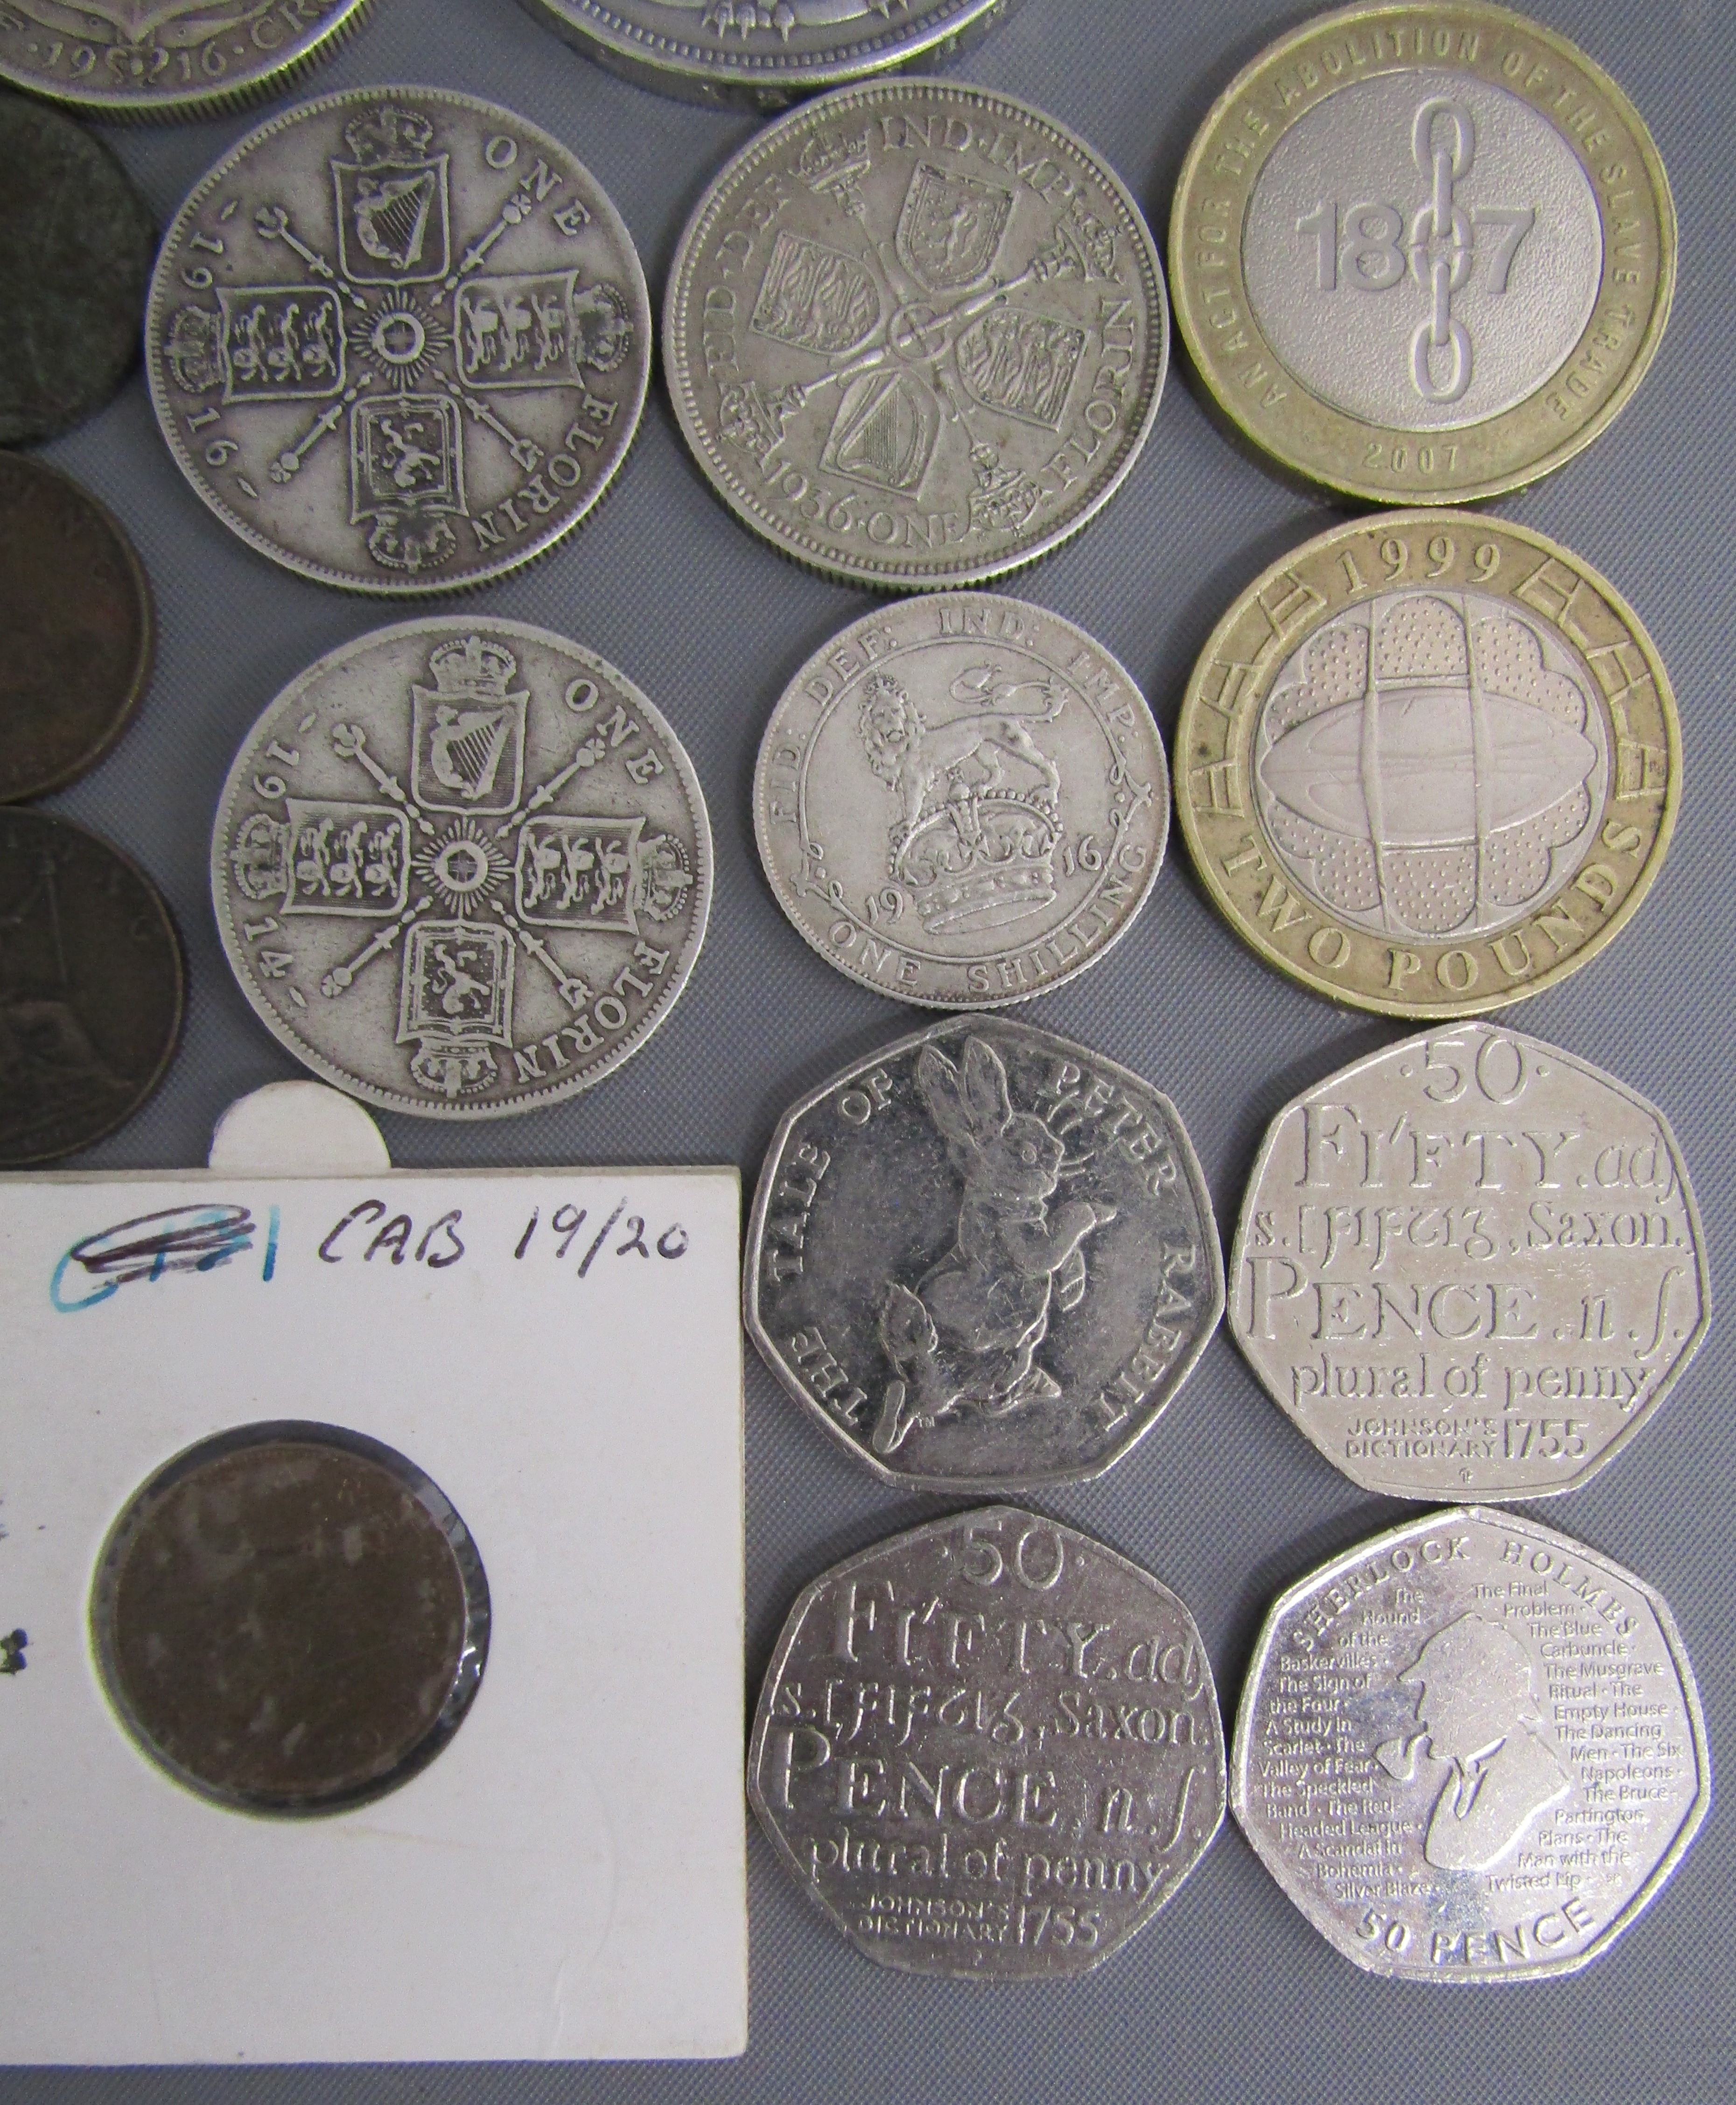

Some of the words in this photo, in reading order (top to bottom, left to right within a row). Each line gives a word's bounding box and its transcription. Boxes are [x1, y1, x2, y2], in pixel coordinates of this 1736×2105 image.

[1274, 27, 1480, 109] ABOLITION
[1502, 50, 1549, 89] OF
[1551, 87, 1613, 154] THE
[1214, 109, 1269, 176] THE
[486, 134, 592, 236] ONE
[1196, 195, 1231, 268] FOR
[1598, 162, 1642, 285] SLAVE
[1202, 286, 1248, 353] ACT
[1545, 303, 1637, 421] TRADE
[1238, 362, 1288, 409] AN
[866, 510, 973, 550] ONE
[1045, 295, 1136, 495] FLORIN
[1362, 442, 1458, 474] 2007
[471, 393, 620, 552] FLORIN
[1337, 535, 1501, 594] 1999
[565, 678, 665, 784] ONE
[864, 886, 904, 926] 19
[1061, 835, 1103, 877] 16
[828, 920, 922, 988] ONE
[967, 845, 1148, 993] SHILLING
[1220, 835, 1351, 969] TWO
[1387, 819, 1642, 991] POUNDS
[513, 940, 671, 1084] FLORIN
[841, 1067, 894, 1127] OF
[1049, 1061, 1176, 1197] PETER
[768, 1142, 831, 1284] TALE
[319, 1199, 467, 1268] CAB
[514, 1195, 691, 1279] 19/20
[1097, 1240, 1198, 1433] RABBIT
[792, 1324, 868, 1426] THE
[1291, 1352, 1432, 1411] plural
[1442, 1352, 1493, 1399] of
[1346, 1439, 1498, 1459] DICTIONARY
[1503, 1417, 1590, 1460] 1755
[1347, 1417, 1498, 1438] JOHNSON'S
[1292, 1537, 1470, 1652] SHERLOCK
[1498, 1540, 1641, 1638] HOLMES
[1394, 1586, 1425, 1605] The
[1475, 1582, 1506, 1600] The
[1508, 1579, 1550, 1598] Final
[1362, 1607, 1421, 1627] Hound
[1503, 1600, 1577, 1619] Problem
[1338, 1631, 1358, 1648] of
[1360, 1631, 1389, 1648] the
[1528, 1621, 1561, 1639] The
[1562, 1620, 1603, 1638] Blue
[1279, 1651, 1378, 1672] Baskervilles
[1540, 1639, 1629, 1660] Carbuncle
[1279, 1675, 1308, 1693] The
[1312, 1671, 1351, 1695] Sign
[1353, 1672, 1372, 1690] of
[1543, 1662, 1578, 1680] The
[1580, 1660, 1666, 1681] Musgrave
[1269, 1697, 1298, 1714] the
[1302, 1696, 1340, 1714] Four
[1549, 1681, 1598, 1702] Ritual
[1610, 1680, 1645, 1698] The
[1265, 1719, 1279, 1736] A
[1283, 1715, 1332, 1737] Study
[1335, 1715, 1352, 1733] in
[1553, 1704, 1610, 1724] Empty
[1613, 1701, 1670, 1719] House
[1263, 1738, 1322, 1756] Scarlet
[1335, 1735, 1366, 1754] The
[1554, 1724, 1588, 1742] The
[1590, 1721, 1664, 1743] Dancing
[1570, 1744, 1610, 1762] Men
[1619, 1742, 1654, 1761] The
[1657, 1740, 1684, 1759] Six
[1259, 1759, 1309, 1780] Valley
[1313, 1757, 1331, 1775] of
[1334, 1757, 1372, 1775] Fear
[1581, 1762, 1675, 1785] Napoleons
[1261, 1780, 1293, 1799] The
[1295, 1776, 1375, 1801] Speckled
[1582, 1786, 1616, 1803] The
[1265, 1799, 1310, 1819] Band
[1328, 1797, 1359, 1817] The
[1554, 1806, 1647, 1826] Partington
[1279, 1819, 1347, 1842] Headed
[1350, 1819, 1414, 1839] League
[1538, 1829, 1584, 1847] Plans
[1594, 1827, 1629, 1845] The
[808, 1825, 951, 1884] plural
[964, 1836, 1008, 1882] of
[1298, 1843, 1313, 1860] A
[1315, 1838, 1383, 1859] Scandal
[1518, 1851, 1555, 1869] Man
[1559, 1848, 1598, 1866] with
[1600, 1844, 1633, 1866] the
[1317, 1859, 1395, 1880] Bohemia
[1485, 1870, 1552, 1892] Twisted
[1556, 1871, 1583, 1892] Lip
[1335, 1880, 1382, 1899] Silver
[1386, 1879, 1432, 1898] Blaze
[1017, 1903, 1100, 1948] 1755
[1353, 1907, 1412, 1953] 50
[1431, 1895, 1597, 1966] PENCE
